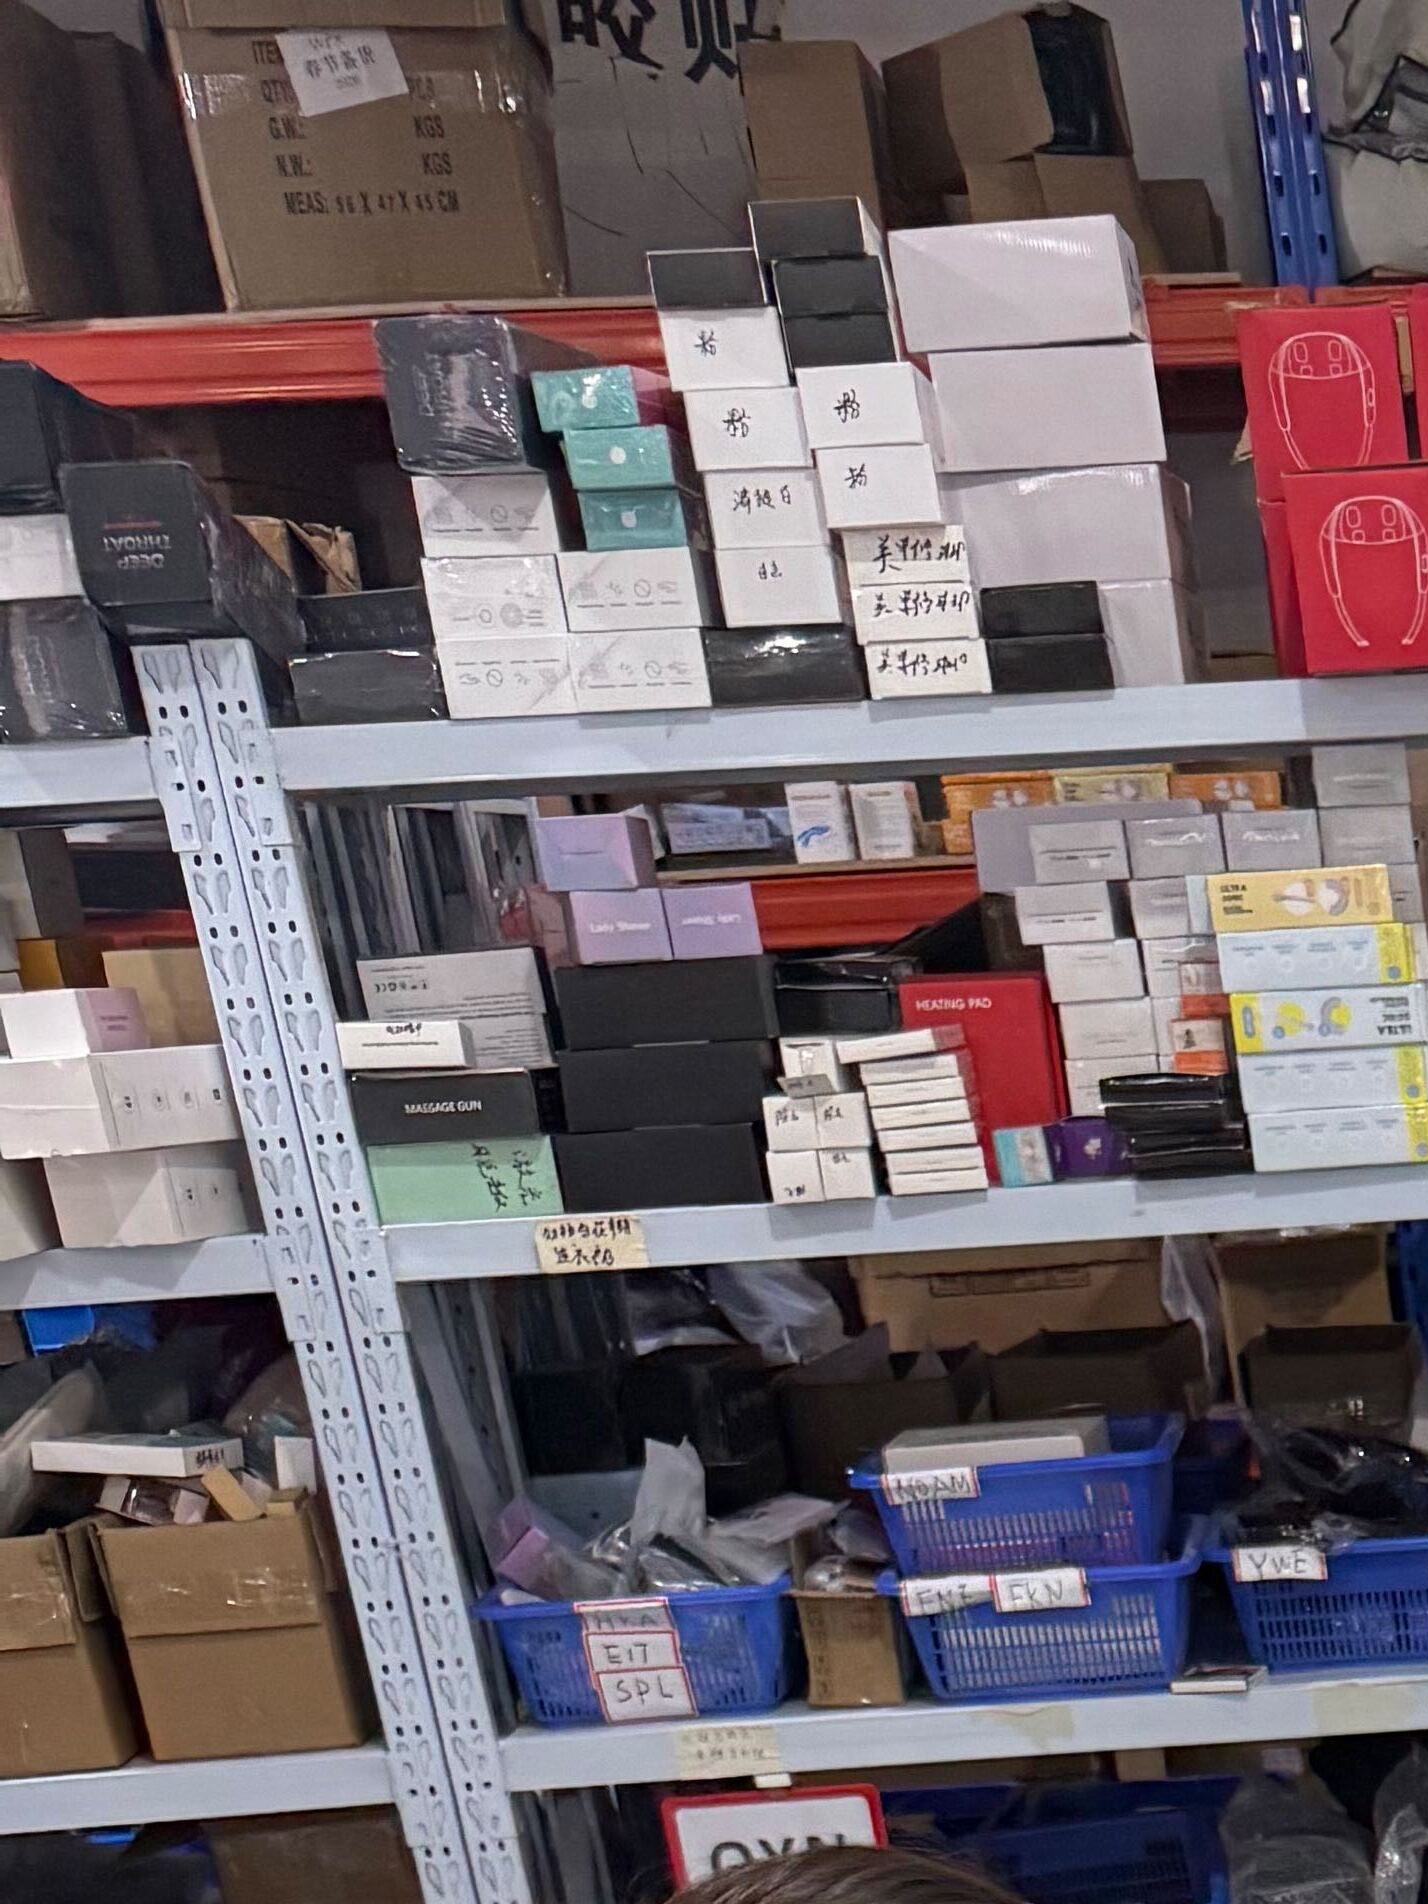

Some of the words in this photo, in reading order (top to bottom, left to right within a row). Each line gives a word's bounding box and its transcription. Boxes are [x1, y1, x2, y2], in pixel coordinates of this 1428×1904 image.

[102, 533, 172, 552] THROAT
[116, 552, 166, 570] DEEP
[404, 1101, 456, 1114] MASSAGE
[457, 1099, 483, 1112] GUN
